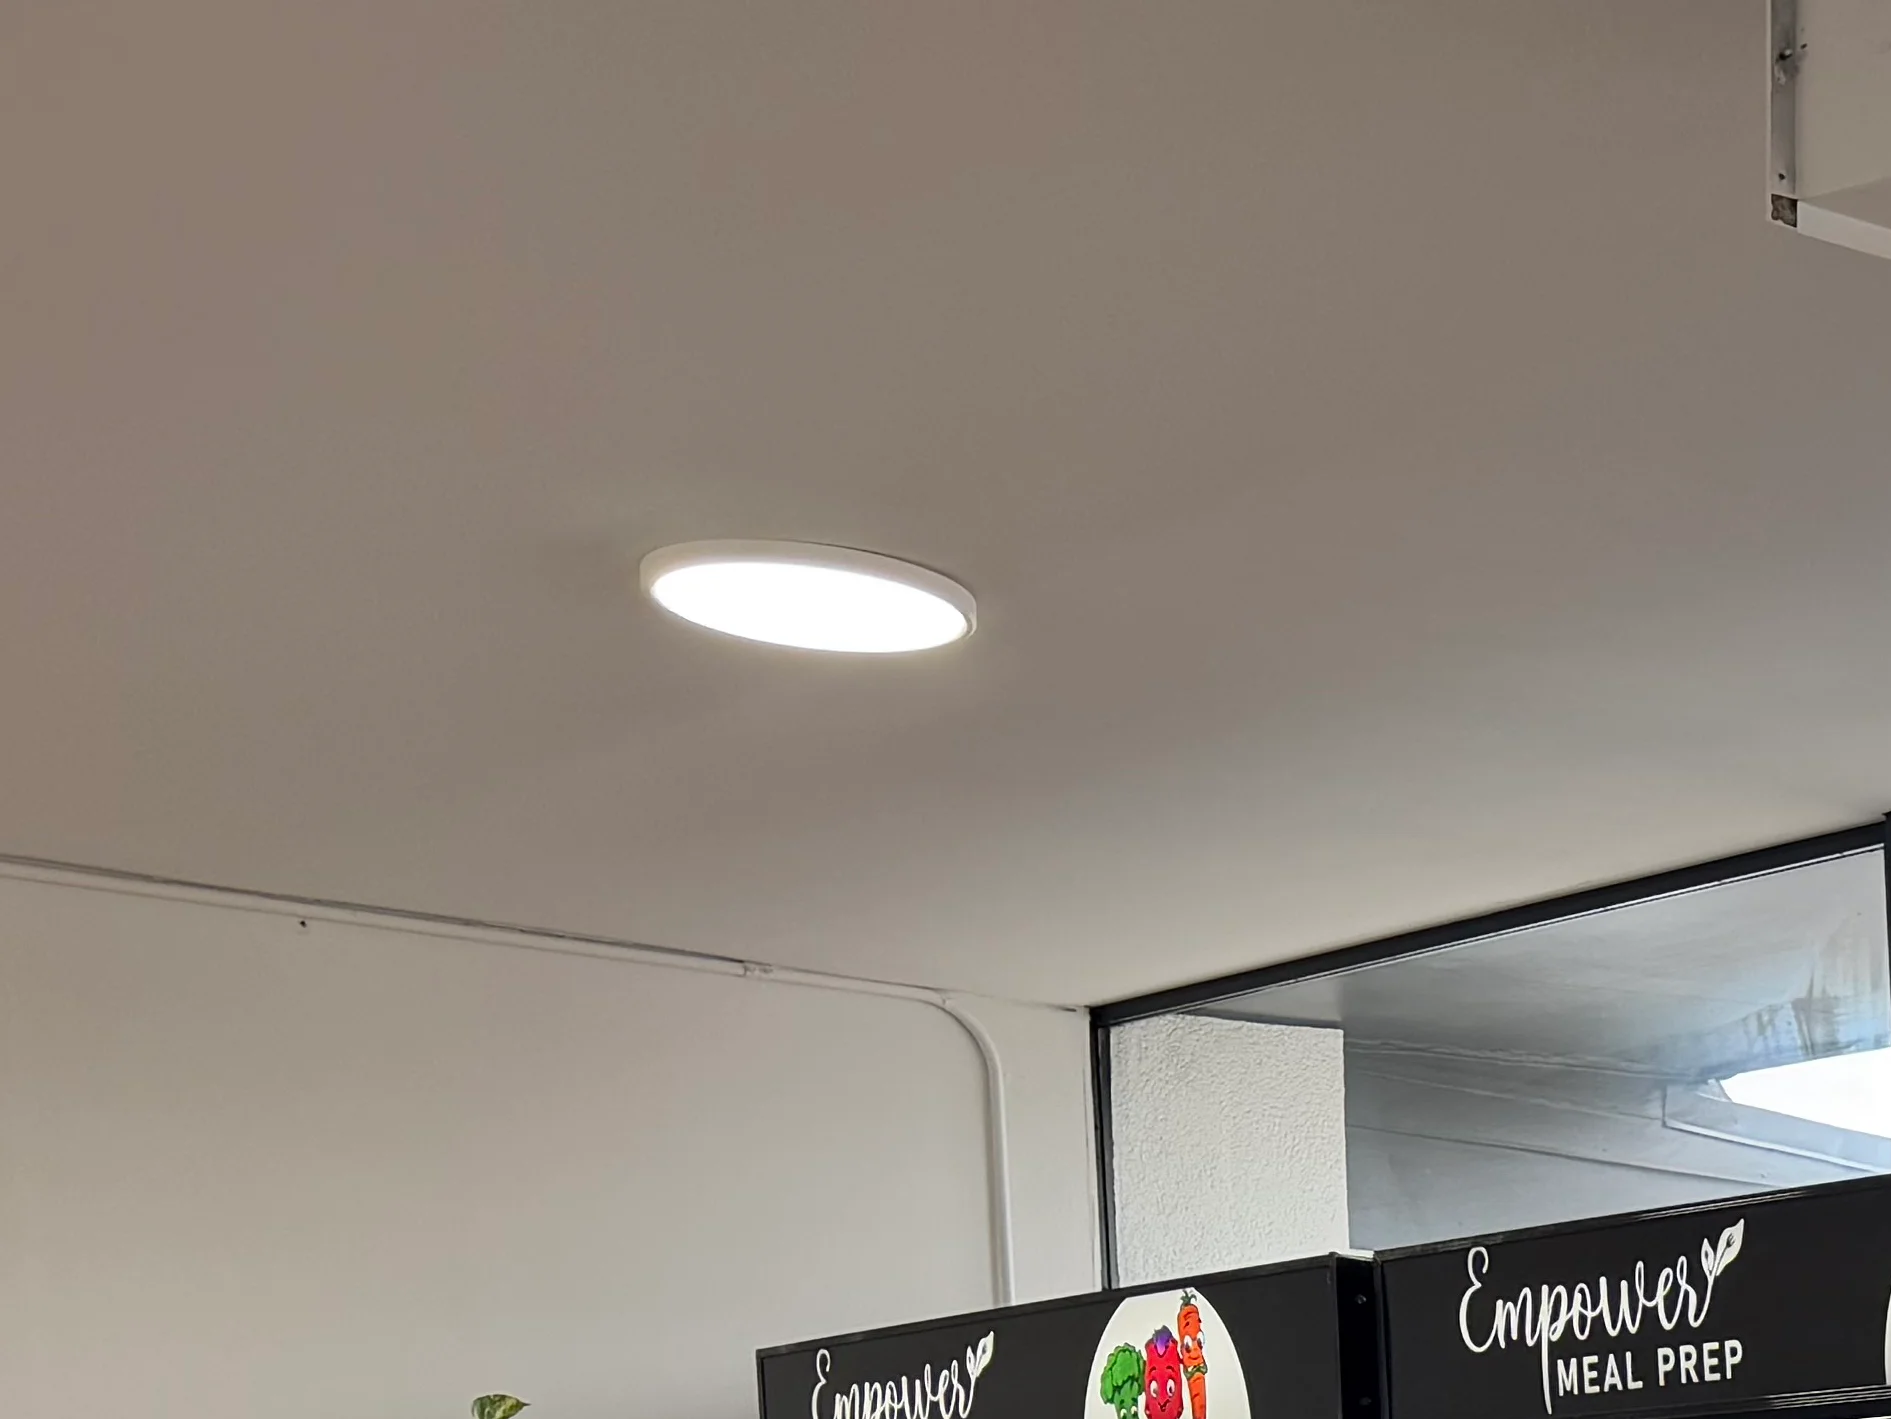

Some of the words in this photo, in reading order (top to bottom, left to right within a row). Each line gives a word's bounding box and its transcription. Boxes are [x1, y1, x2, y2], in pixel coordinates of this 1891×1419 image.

[1459, 1246, 1714, 1414] Empower
[1557, 1351, 1642, 1396] MEAL
[1657, 1339, 1744, 1386] PREP
